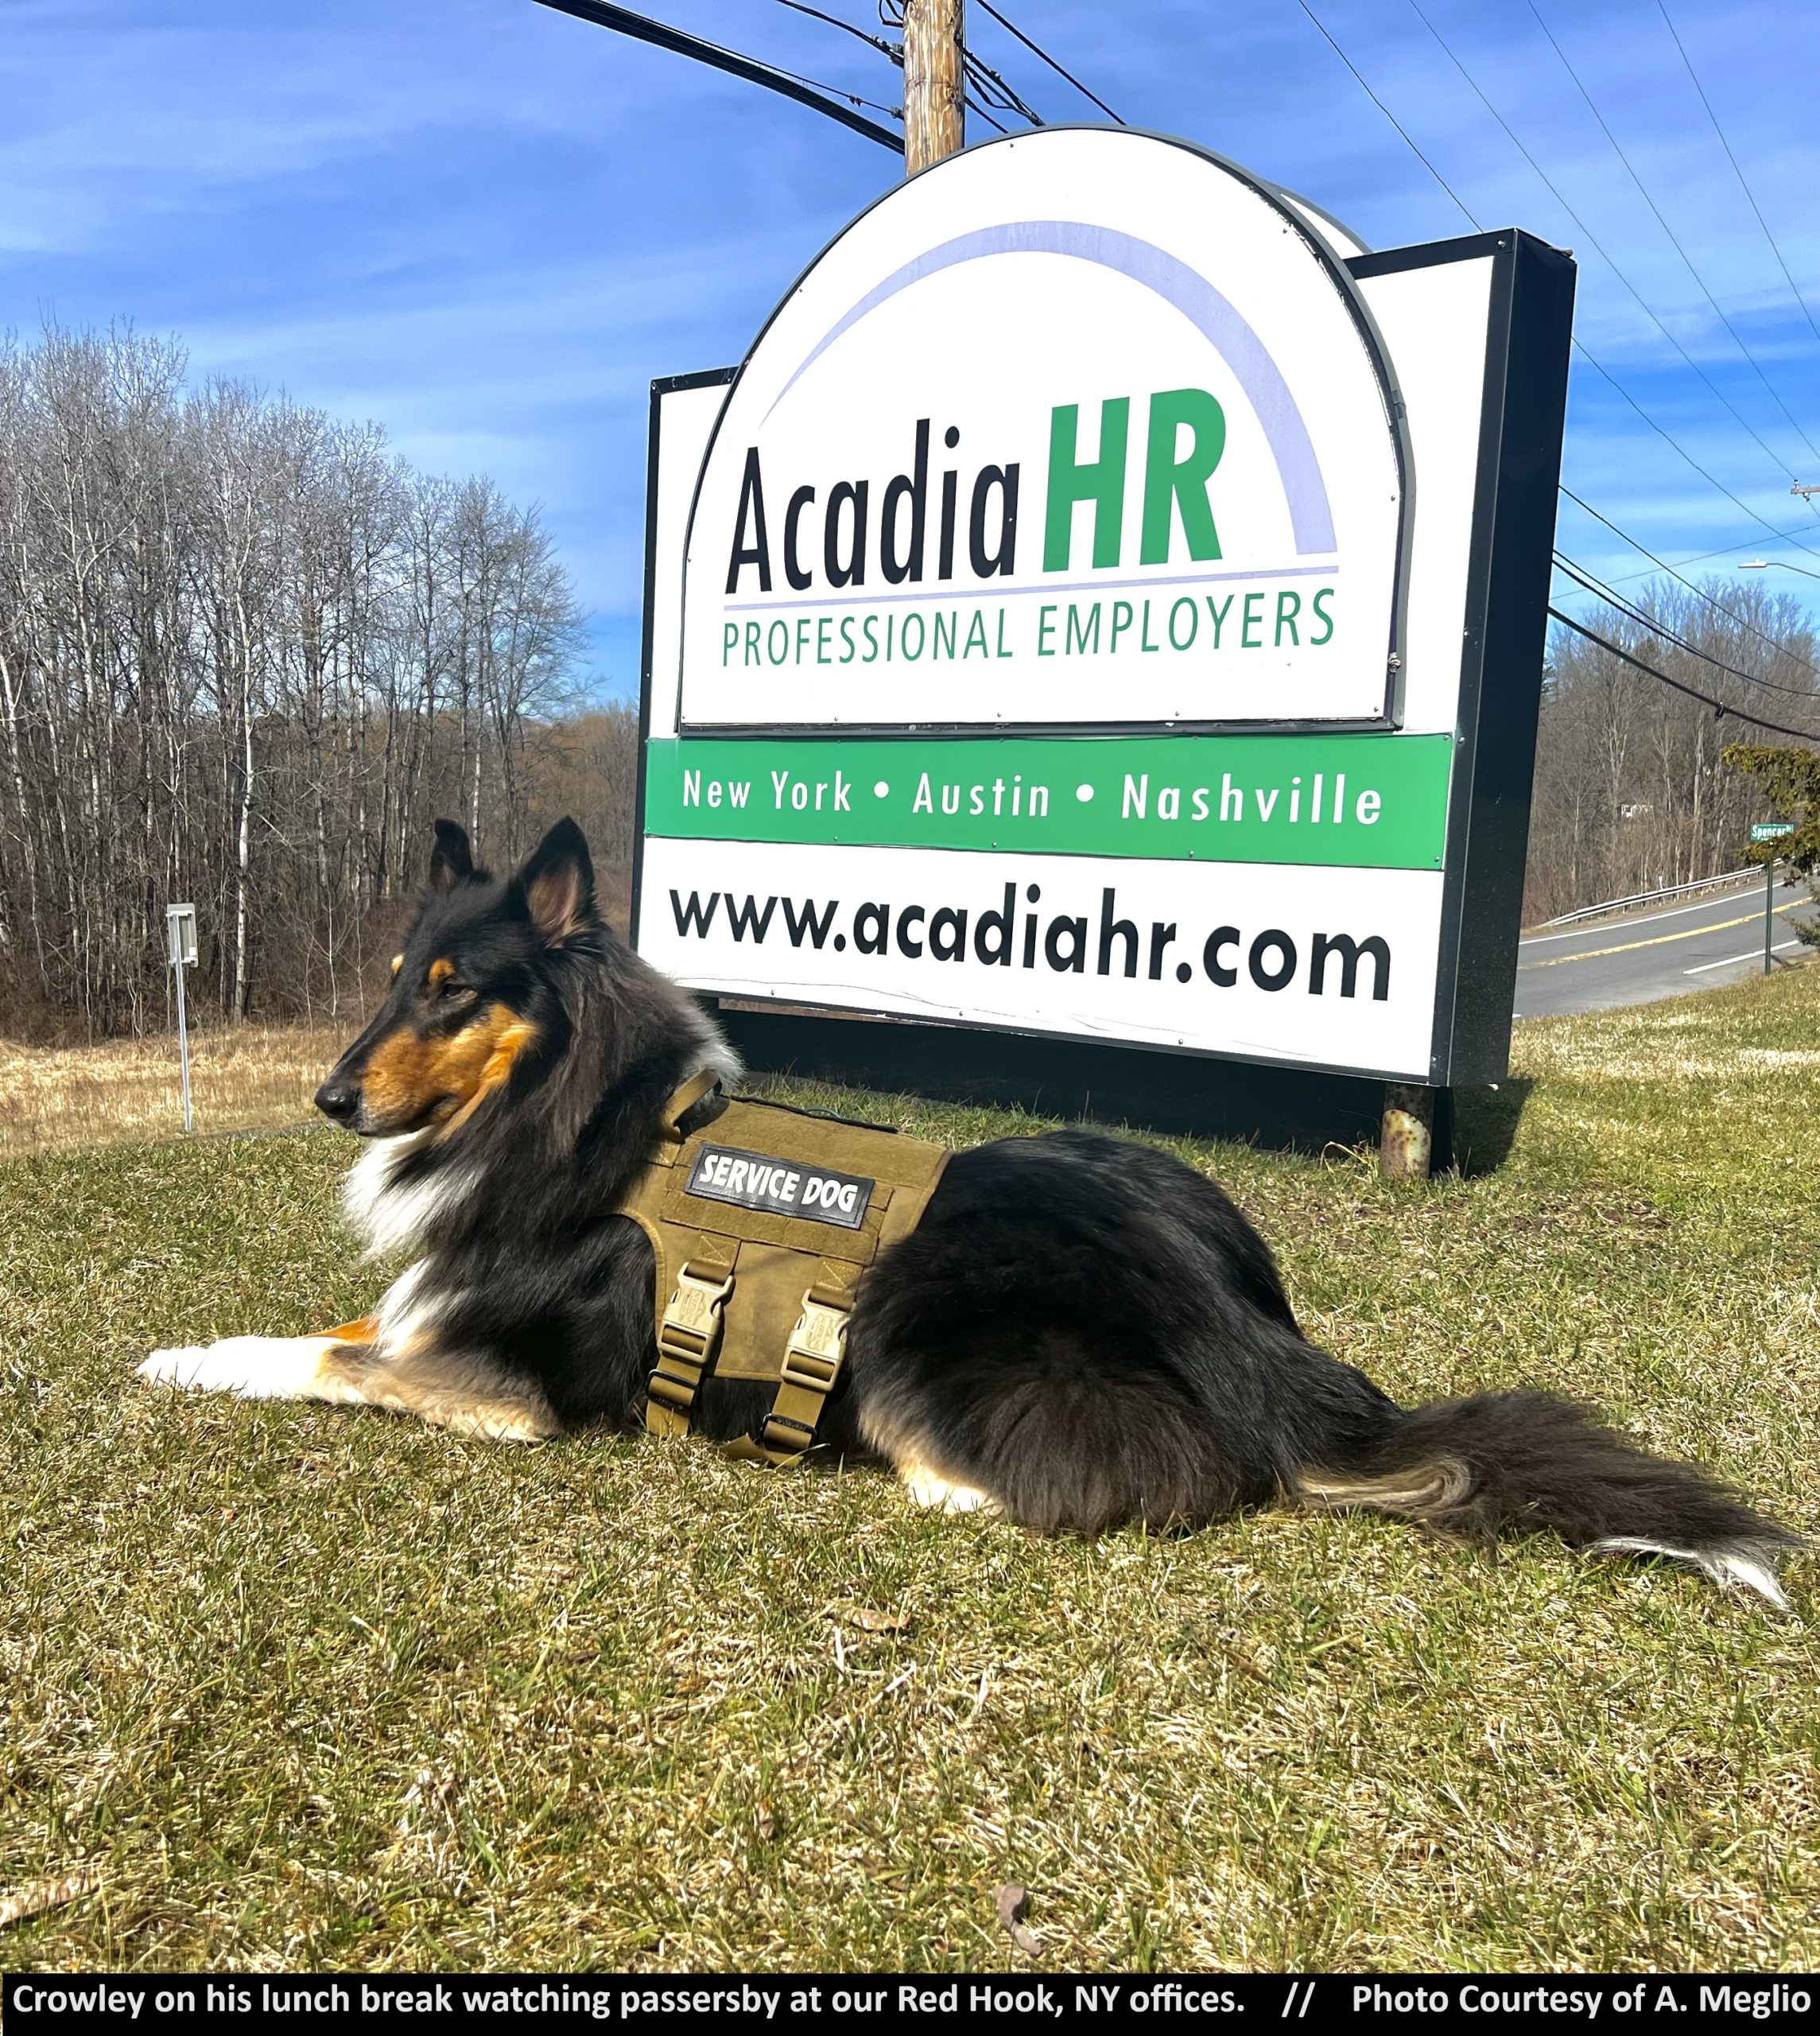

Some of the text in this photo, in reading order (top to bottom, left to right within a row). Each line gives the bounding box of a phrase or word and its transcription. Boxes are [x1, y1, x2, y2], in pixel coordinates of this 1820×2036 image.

[723, 588, 1336, 666] PROFESSIONAL EMPLOYERS
[682, 769, 1382, 826] New York Austin Nashville
[1752, 825, 1786, 840] Spencer
[668, 881, 1391, 1002] www.acadiahr.com
[699, 1154, 859, 1213] SERVICE DOG
